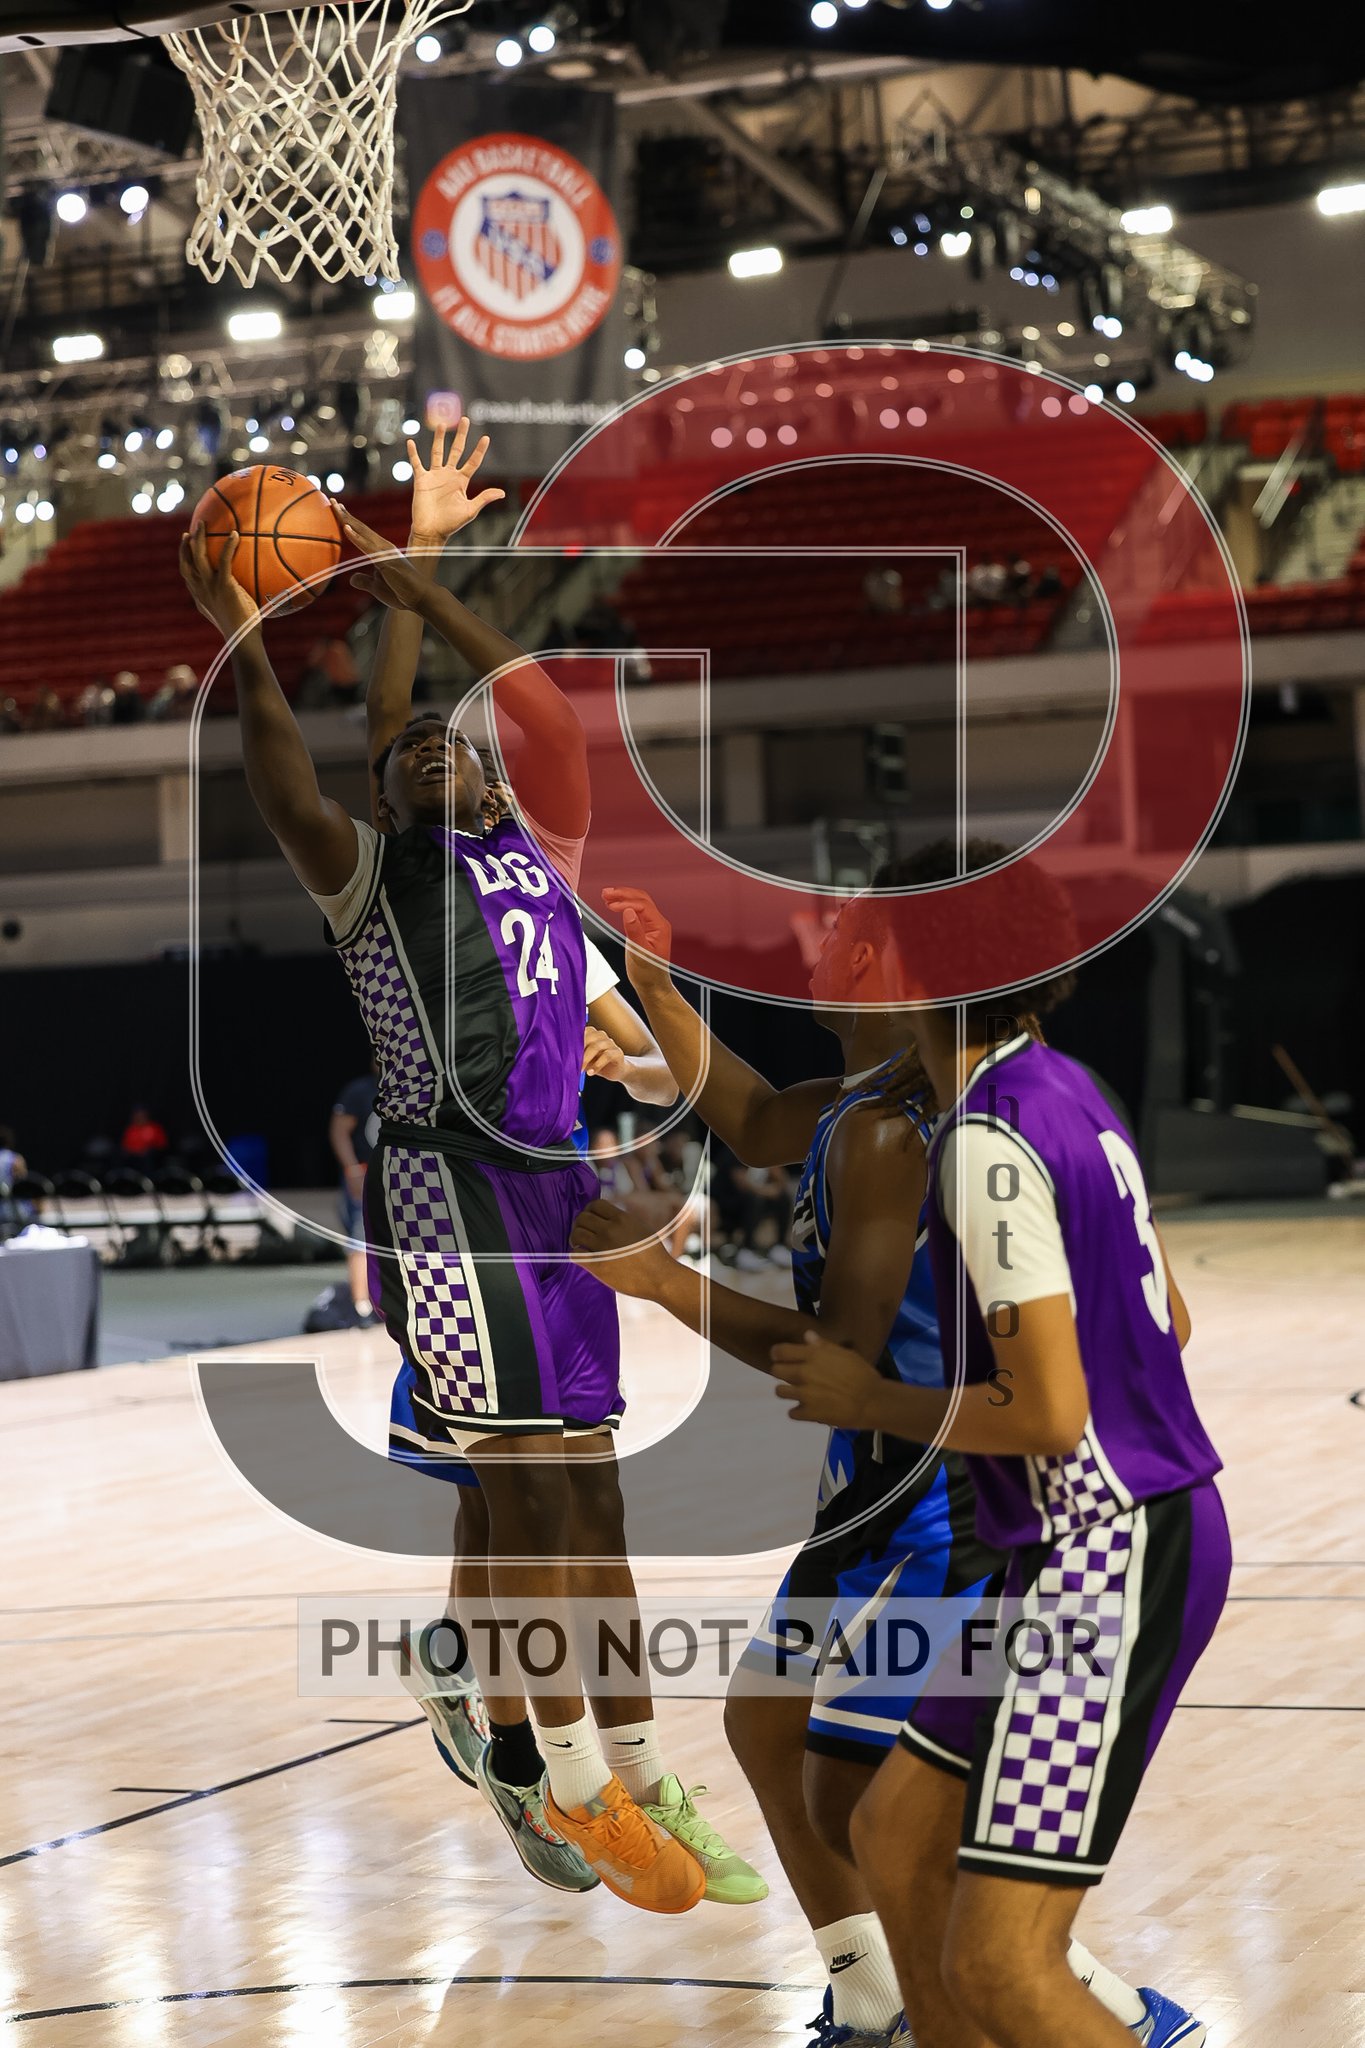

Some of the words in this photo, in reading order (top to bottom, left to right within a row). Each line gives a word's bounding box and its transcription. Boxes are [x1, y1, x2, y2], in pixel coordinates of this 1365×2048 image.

[501, 909, 559, 998] 24
[1098, 1130, 1171, 1334] 3
[832, 1951, 857, 1967] NIKE
